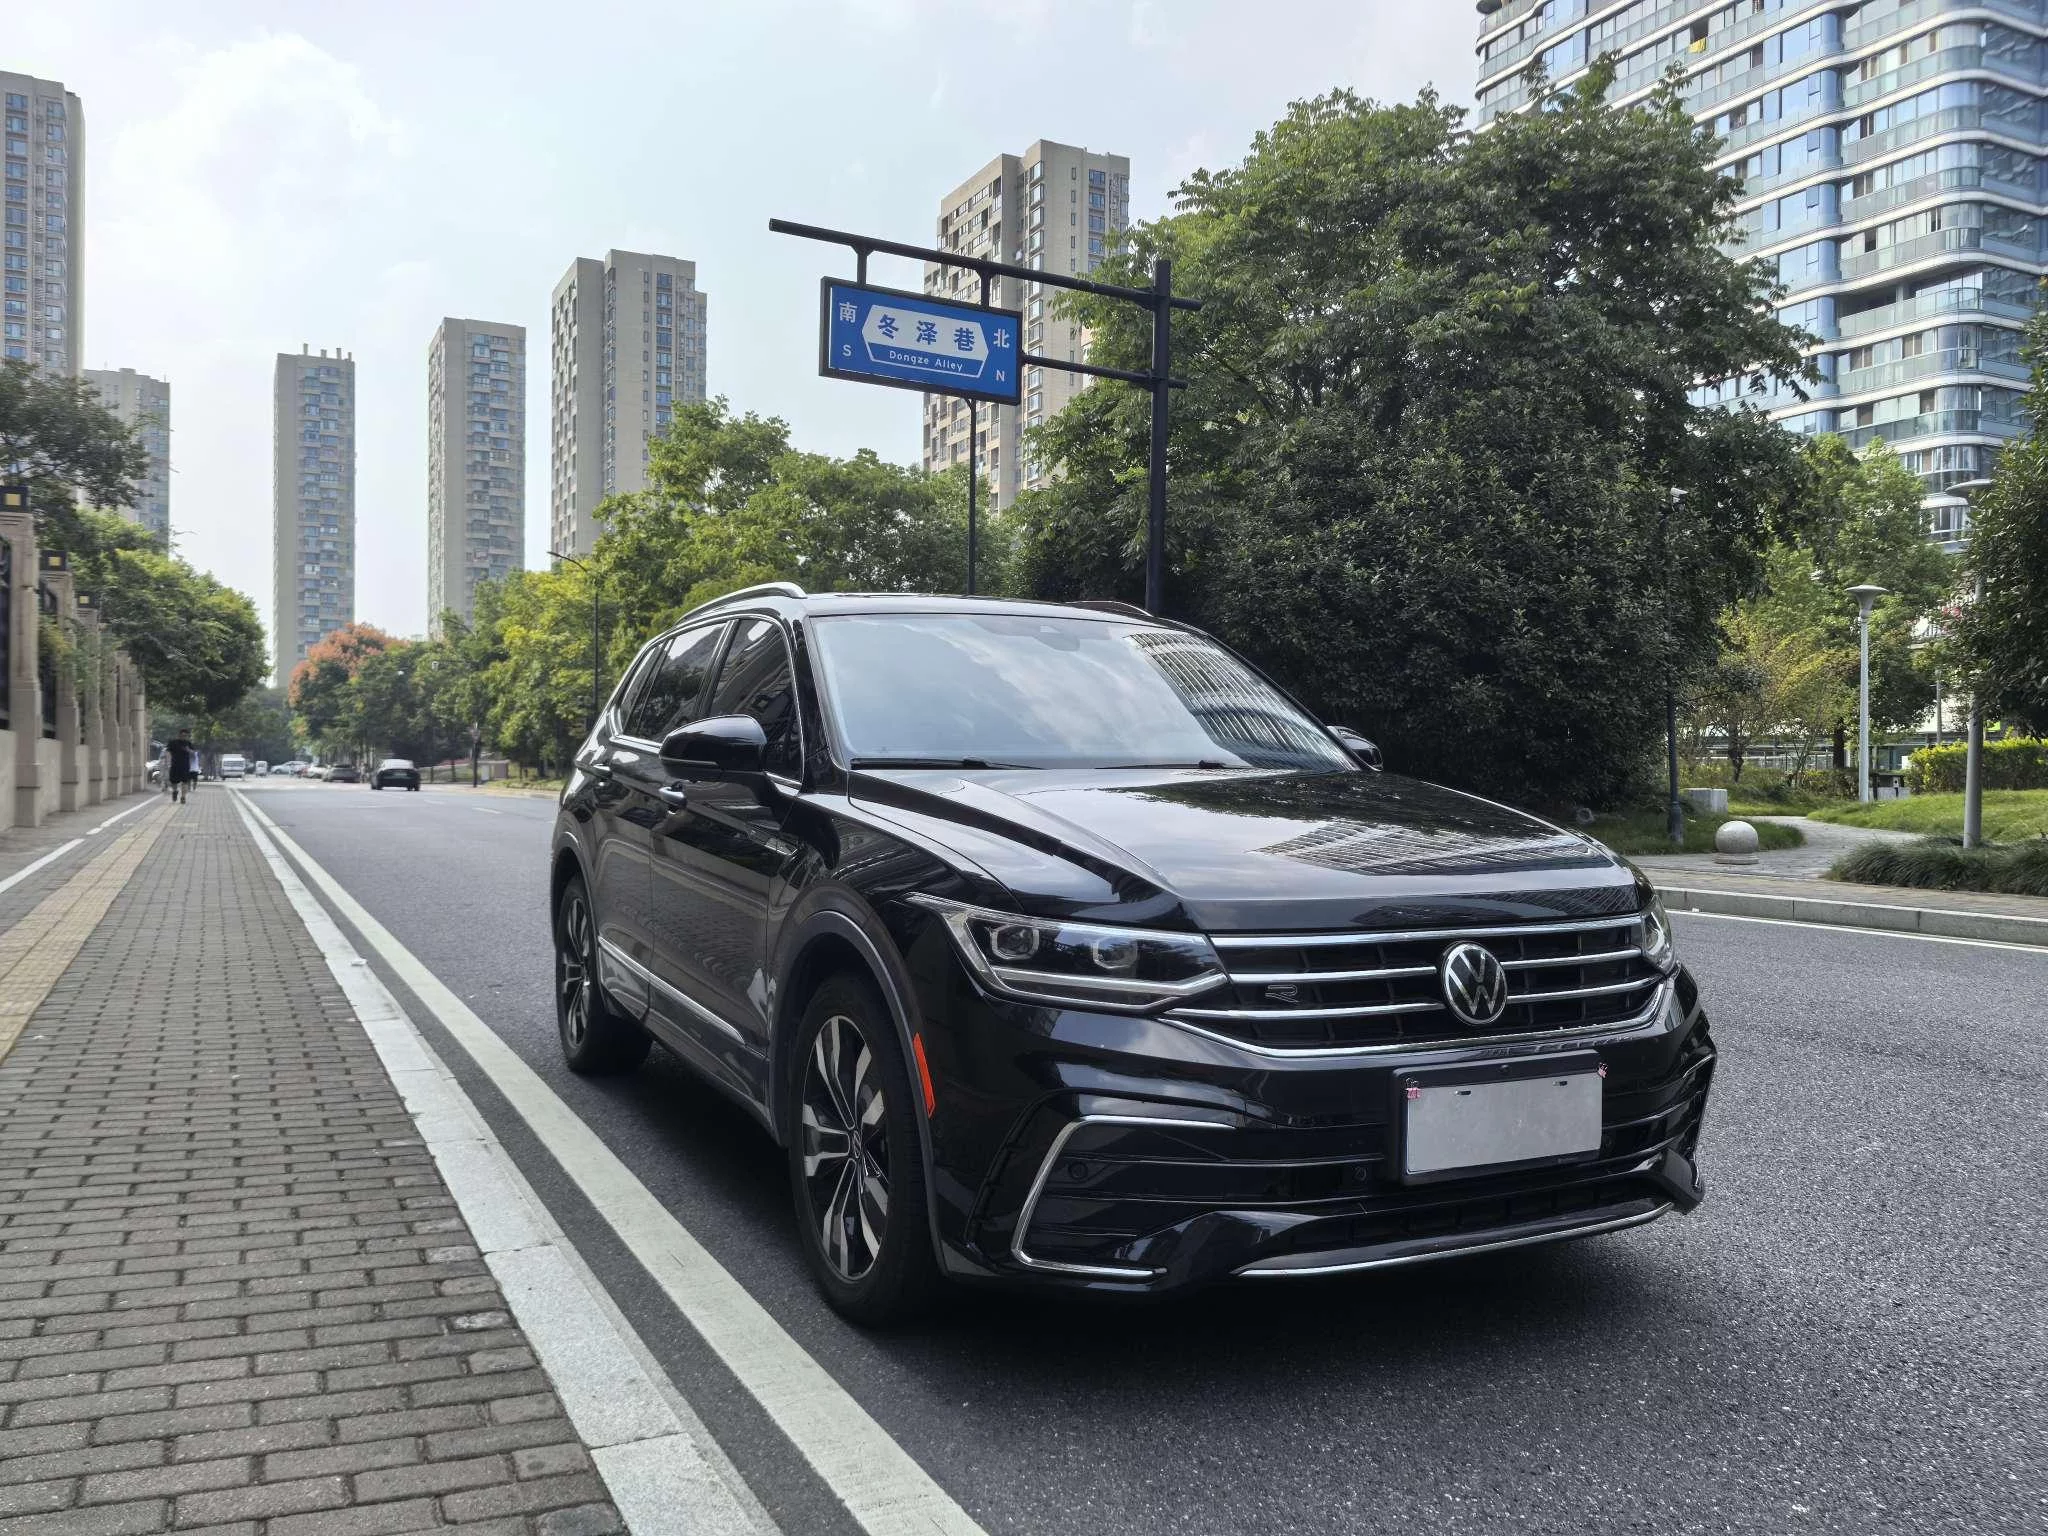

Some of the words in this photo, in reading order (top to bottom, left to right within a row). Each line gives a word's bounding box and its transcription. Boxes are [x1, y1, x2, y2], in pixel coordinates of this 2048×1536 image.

[839, 301, 858, 323] 南
[877, 313, 976, 352] 冬泽巷
[993, 328, 1010, 350] 北
[842, 344, 852, 357] S
[889, 350, 930, 366] Dongze
[934, 357, 963, 372] Alley
[996, 370, 1005, 382] N
